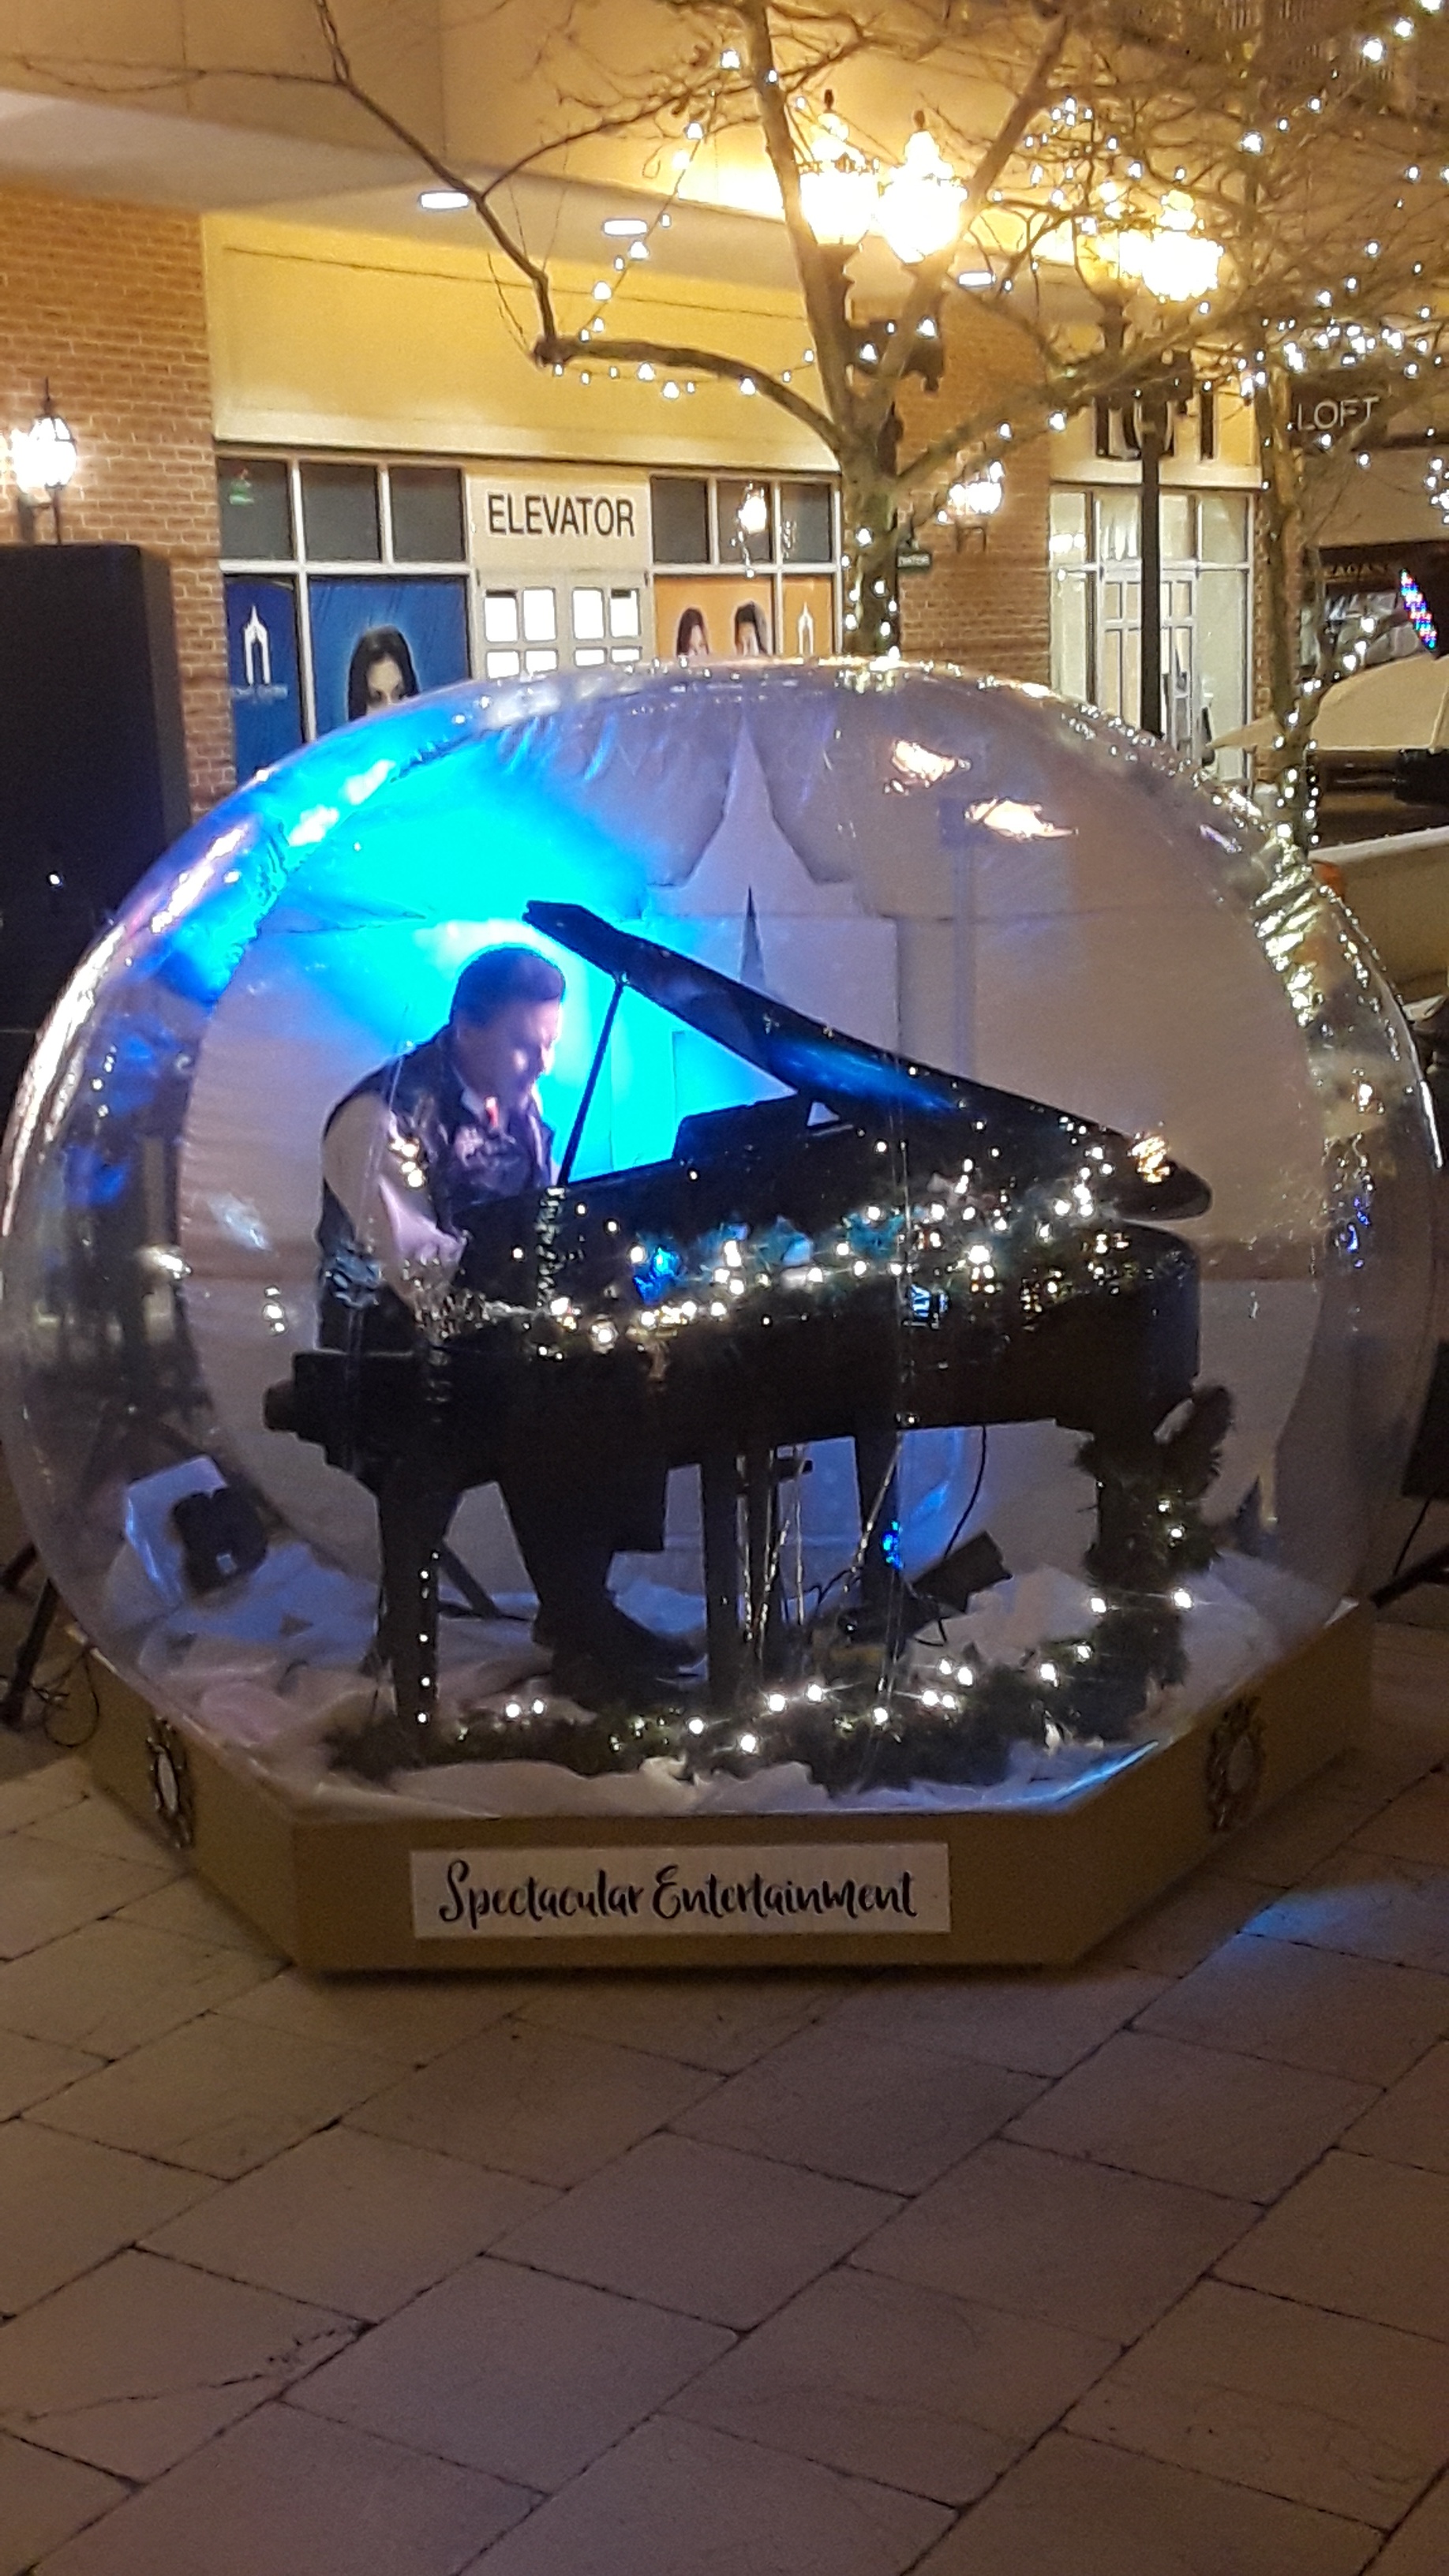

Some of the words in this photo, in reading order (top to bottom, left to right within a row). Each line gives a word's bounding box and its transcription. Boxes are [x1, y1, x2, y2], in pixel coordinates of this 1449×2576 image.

[1297, 396, 1380, 430] LOFT
[487, 493, 635, 537] ELEVATOR
[439, 1859, 644, 1930] Spectacular
[652, 1864, 918, 1919] Entertainment
